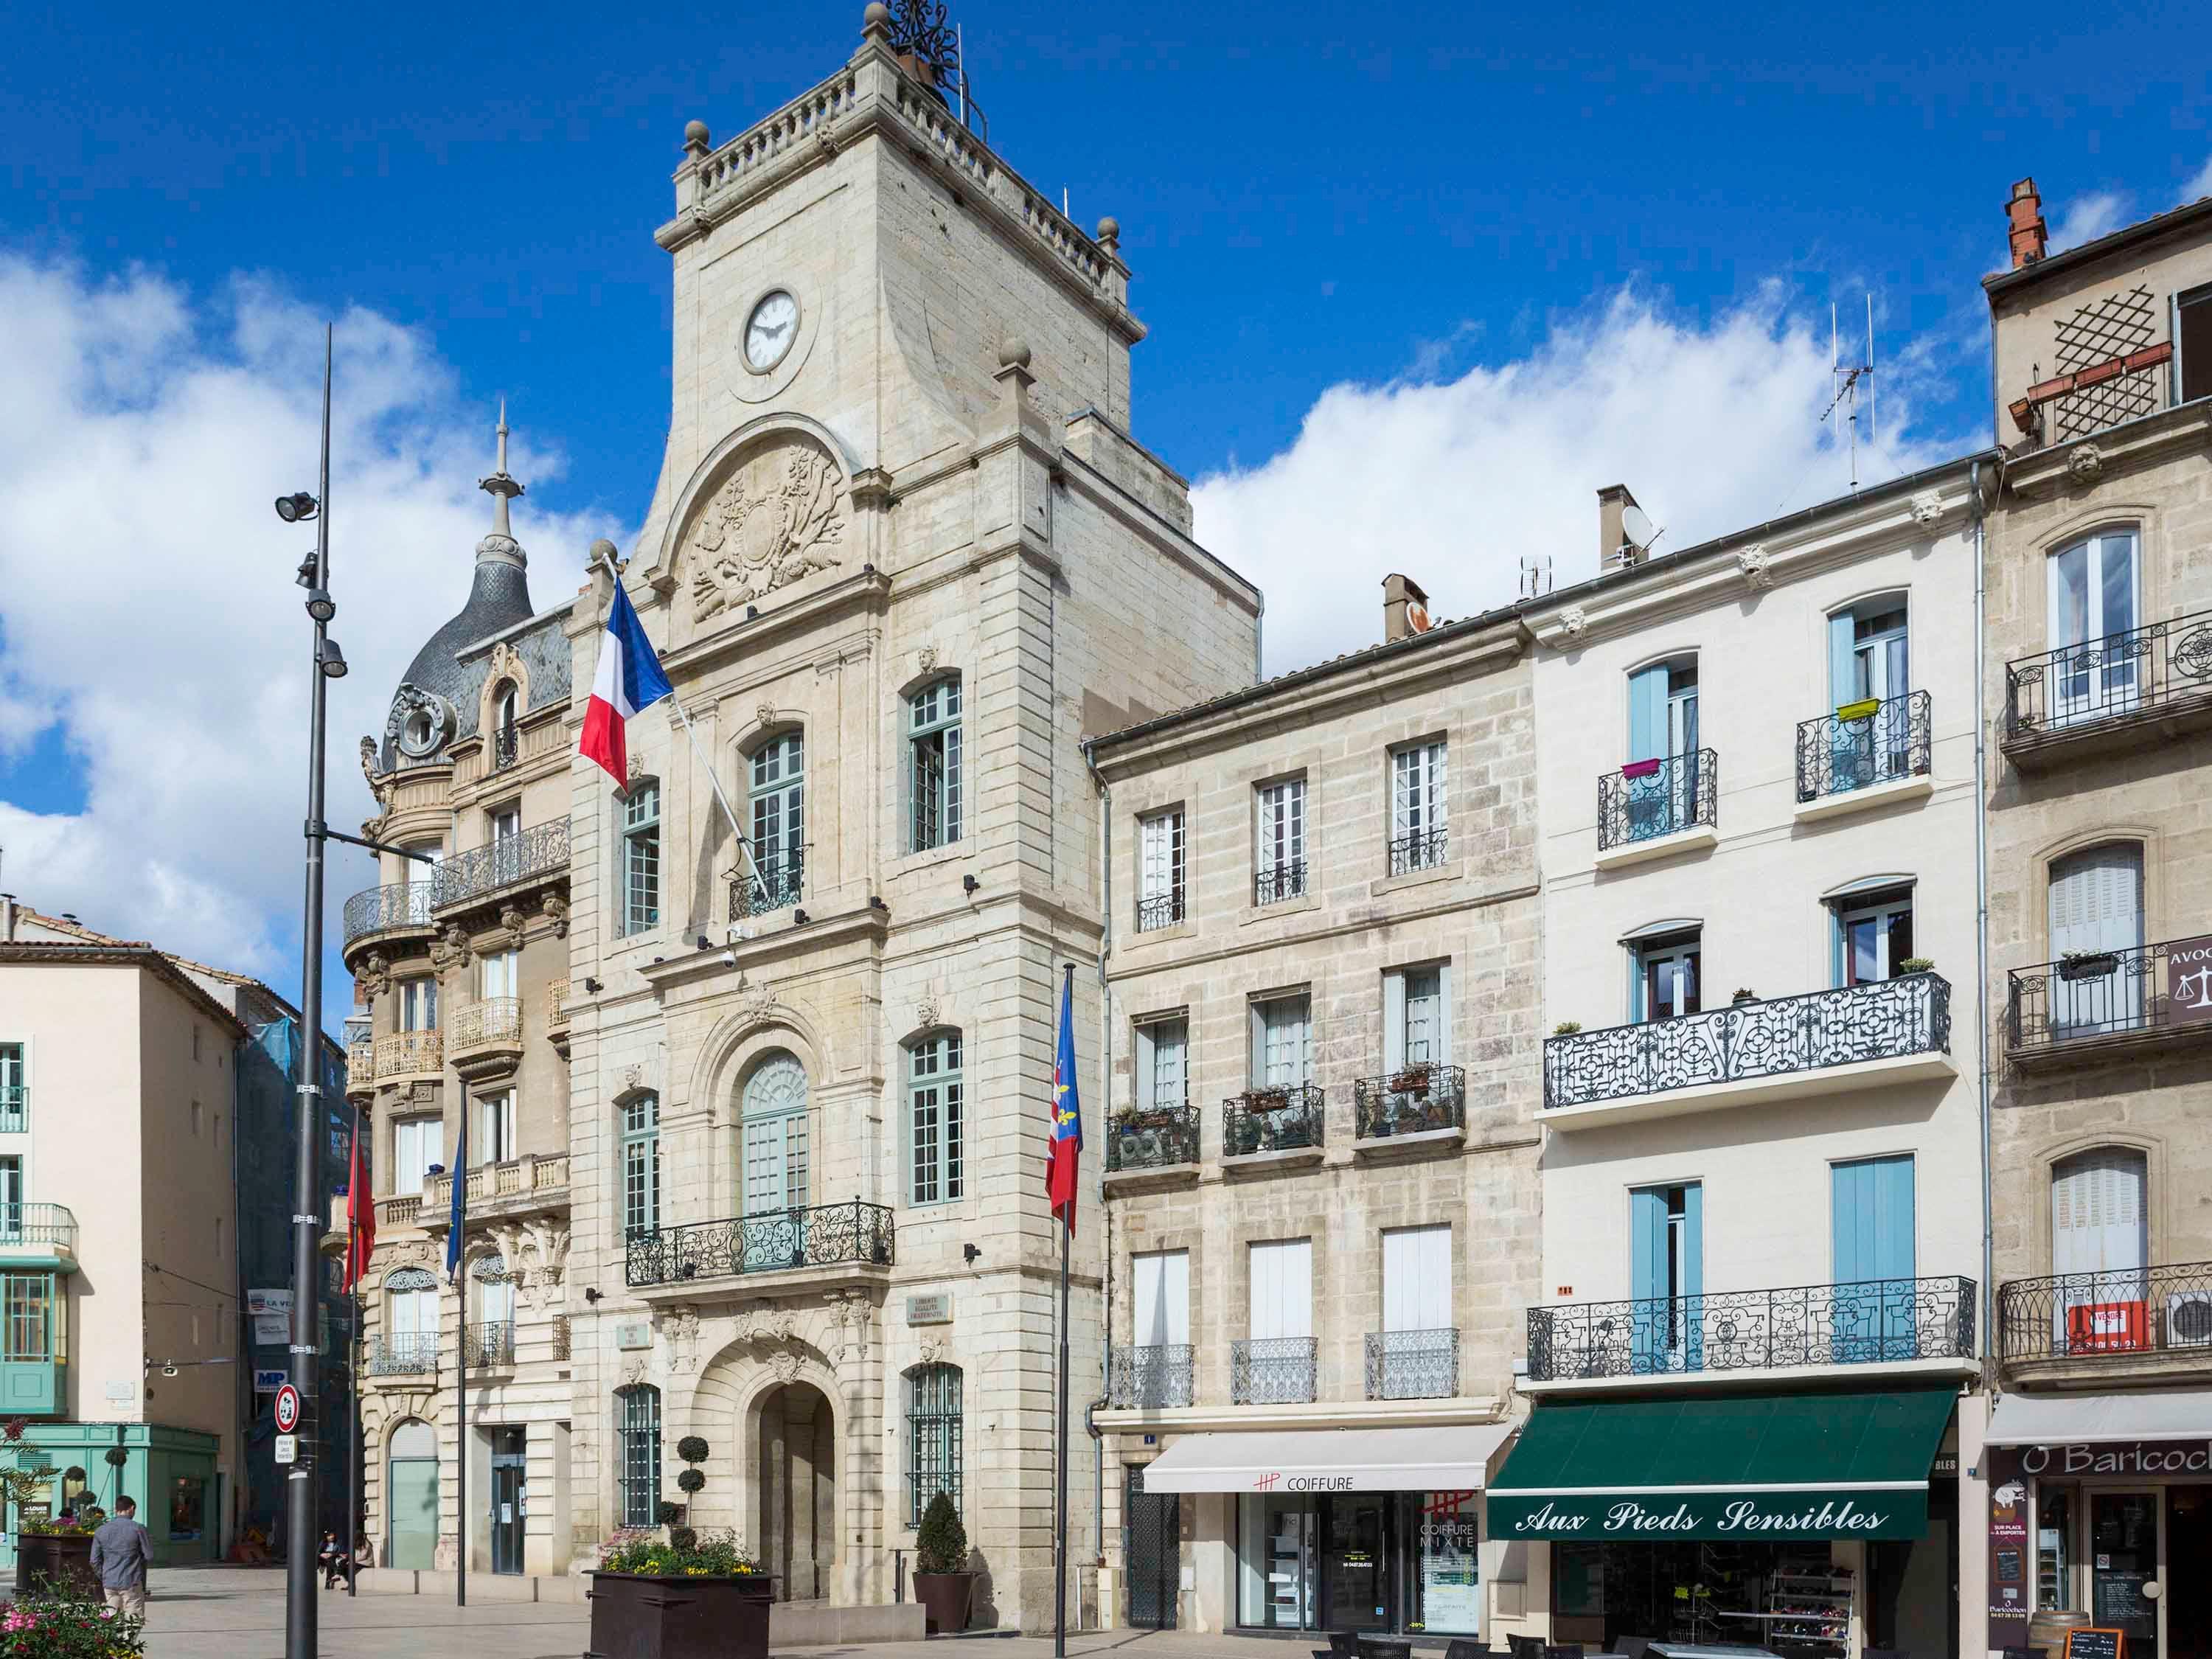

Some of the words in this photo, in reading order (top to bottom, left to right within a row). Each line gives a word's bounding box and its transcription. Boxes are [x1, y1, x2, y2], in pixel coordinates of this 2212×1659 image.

[2065, 1441, 2212, 1472] Baricoc
[1935, 1460, 1956, 1470] BLES
[1287, 1477, 1354, 1491] COIFFURE
[1515, 1503, 1590, 1531] Aux
[1603, 1502, 1703, 1531] Pieds
[1717, 1500, 1889, 1531] Sensibles
[1420, 1524, 1474, 1535] COIFFURE
[1420, 1537, 1474, 1548] MIXTE
